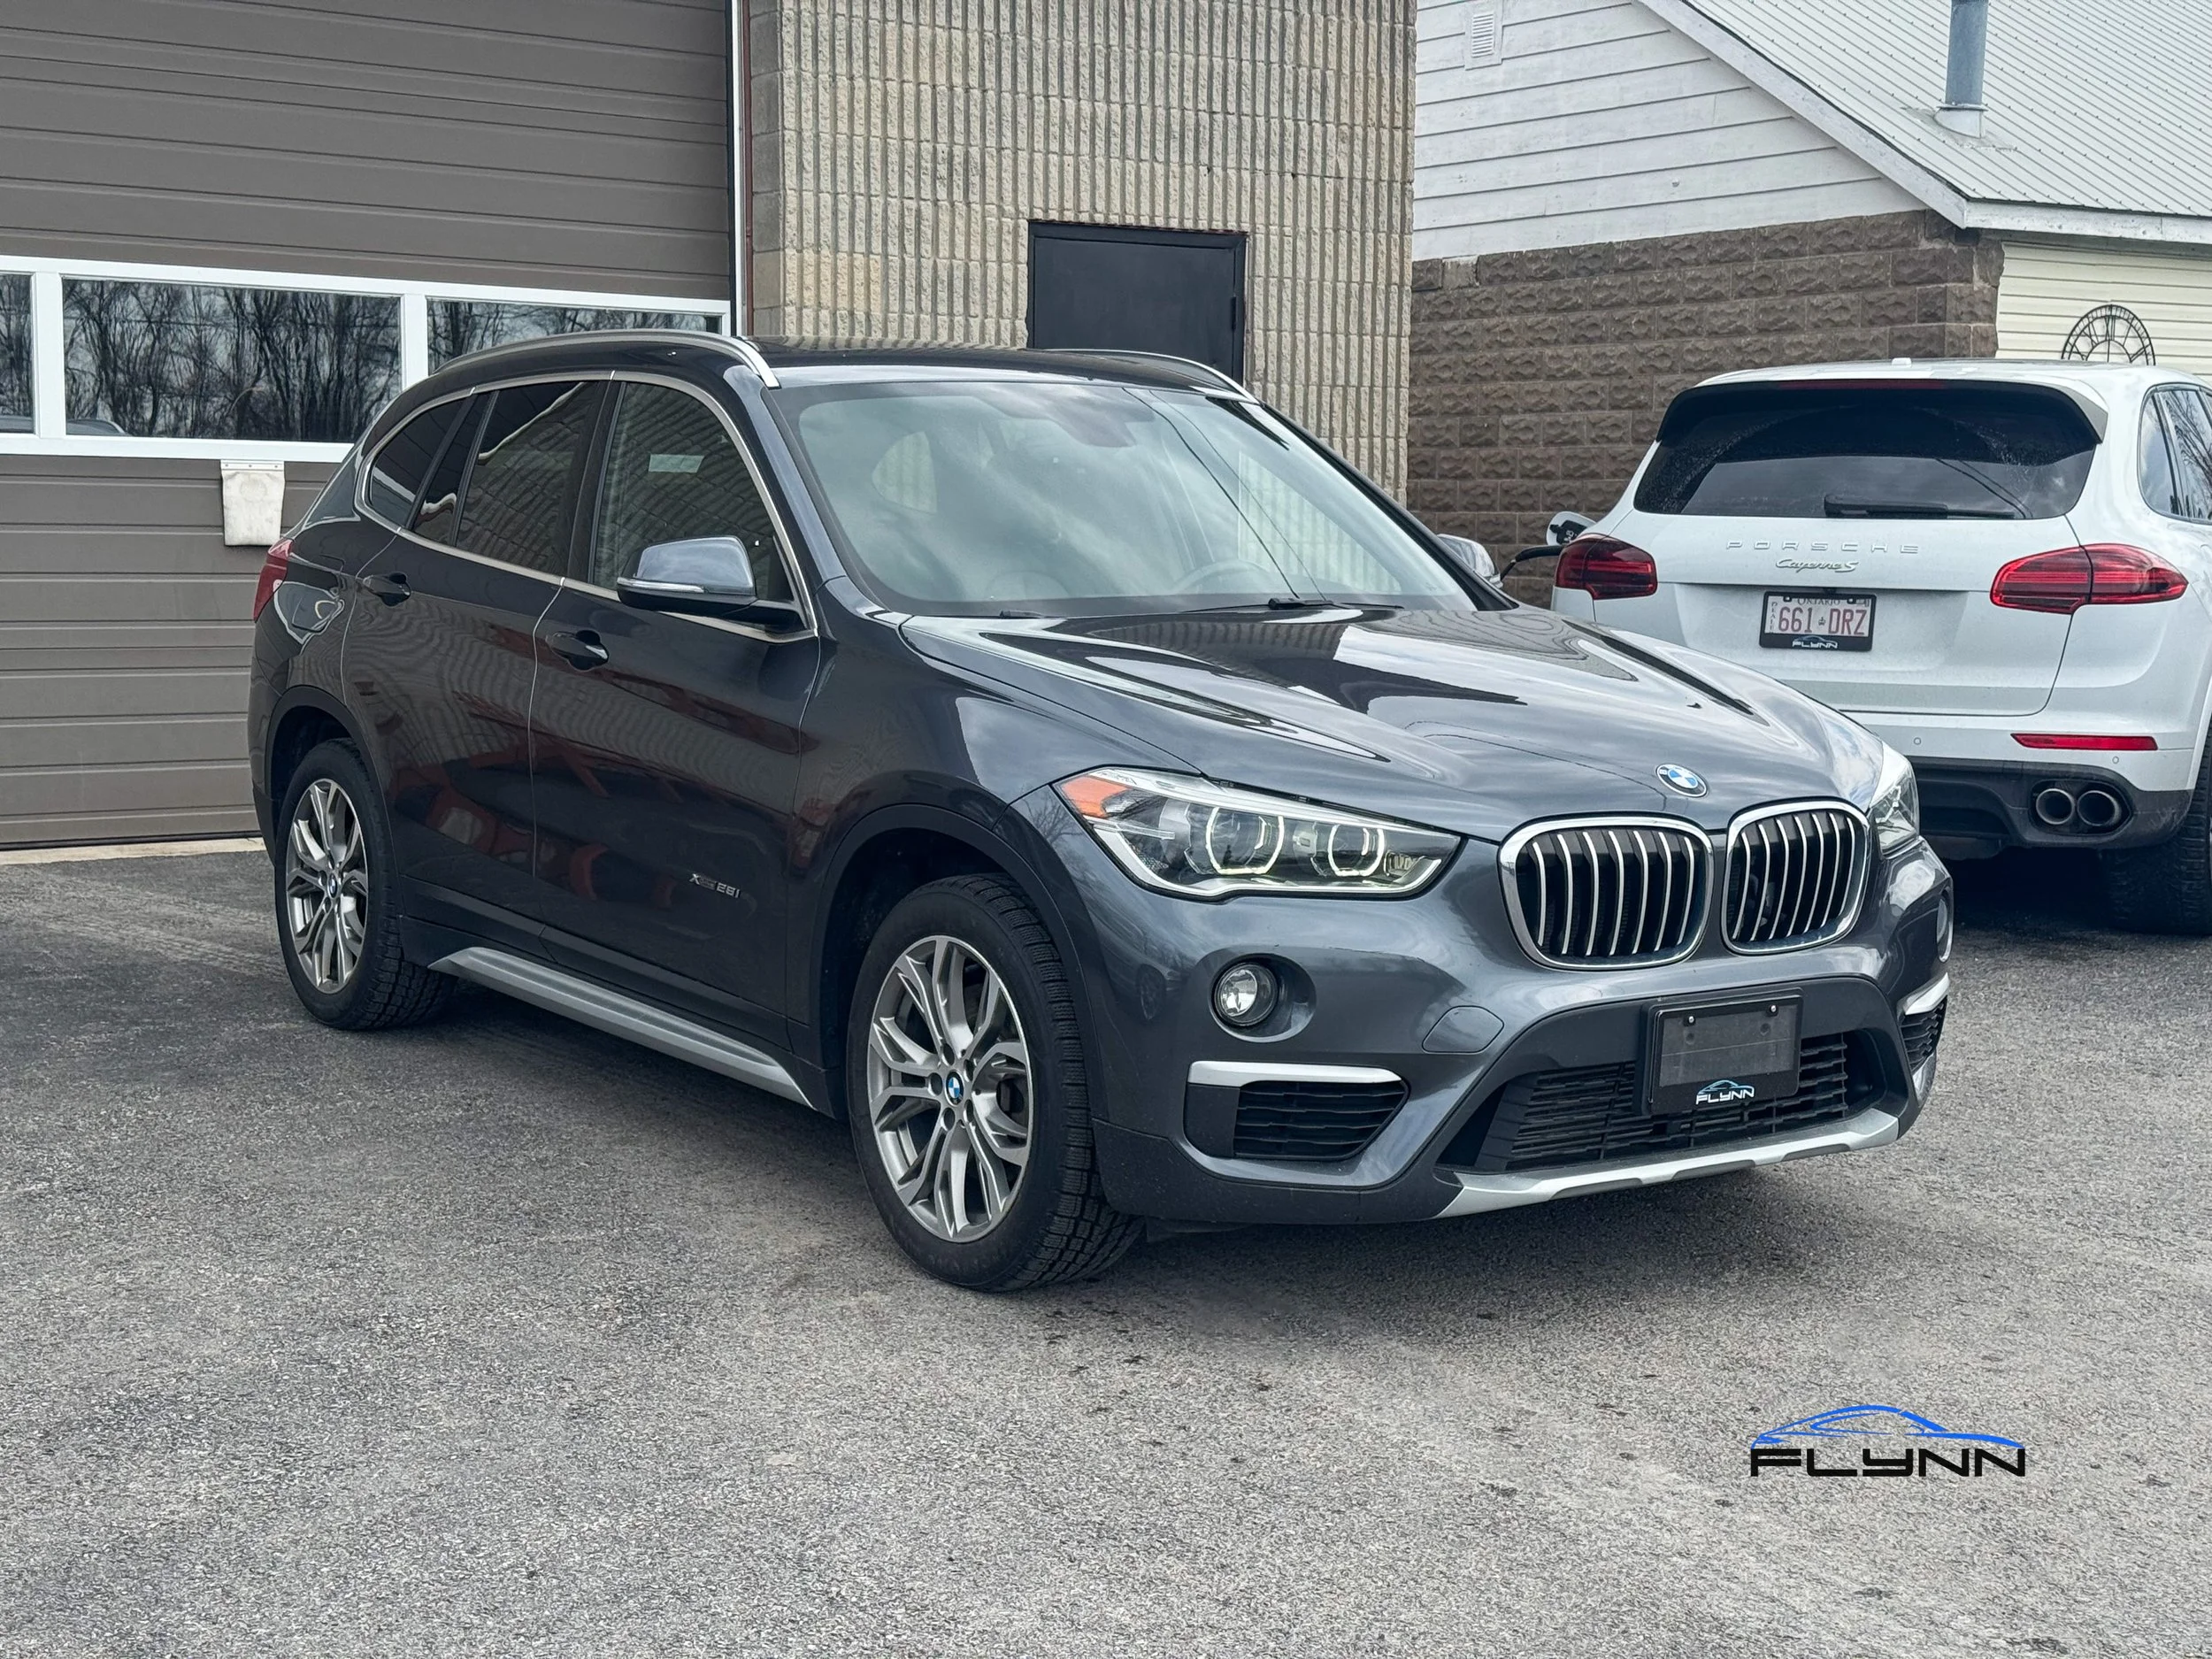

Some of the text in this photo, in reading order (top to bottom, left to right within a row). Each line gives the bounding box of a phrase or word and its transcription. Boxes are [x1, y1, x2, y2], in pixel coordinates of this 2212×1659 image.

[1726, 540, 1920, 555] PORSCHE
[1778, 606, 1868, 635] 661 DRZ
[1792, 640, 1839, 649] FLYNN
[1695, 1088, 1755, 1105] FLYNN
